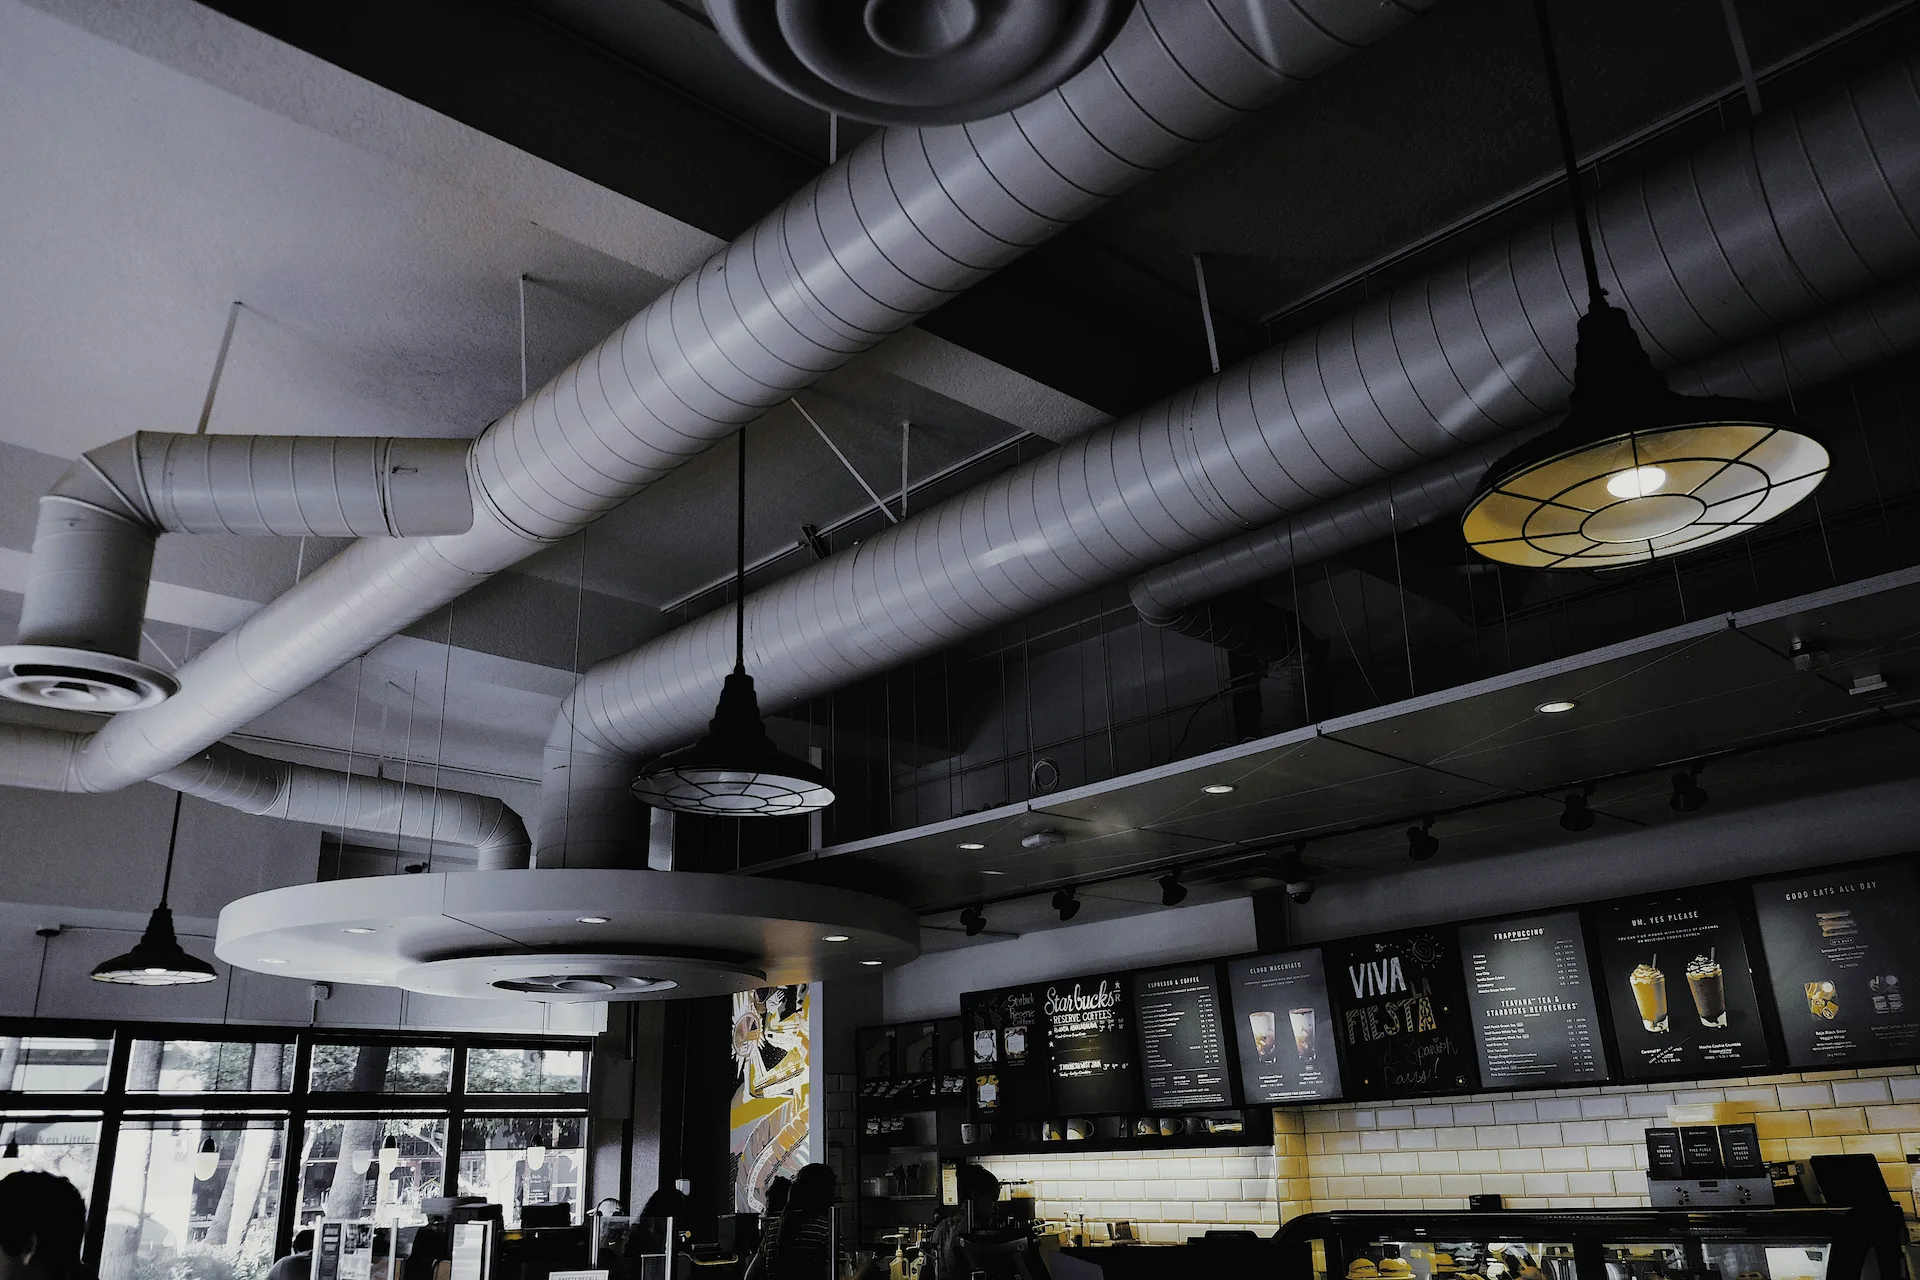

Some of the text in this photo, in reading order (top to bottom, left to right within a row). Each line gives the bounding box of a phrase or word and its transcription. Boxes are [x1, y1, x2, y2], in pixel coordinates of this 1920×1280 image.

[1786, 881, 1877, 901] GOOD EATS ALL DAY
[1650, 916, 1664, 925] YES
[1668, 910, 1699, 922] PLEASE
[1250, 962, 1302, 974] CLOUD MACCHIATO
[1148, 980, 1173, 989] ESPRESSO
[1180, 976, 1200, 985] COFFEE
[1349, 956, 1407, 998] VIVA
[1044, 980, 1114, 1016] Starbucks
[1501, 1000, 1532, 1008] TEAVANA
[1538, 996, 1552, 1004] TEA
[1054, 1009, 1112, 1024] RESERVE COFFEES
[1486, 1003, 1576, 1017] STARBUCKS REFRESHERS
[1346, 997, 1436, 1044] FIESTA
[64, 1132, 91, 1144] Little
